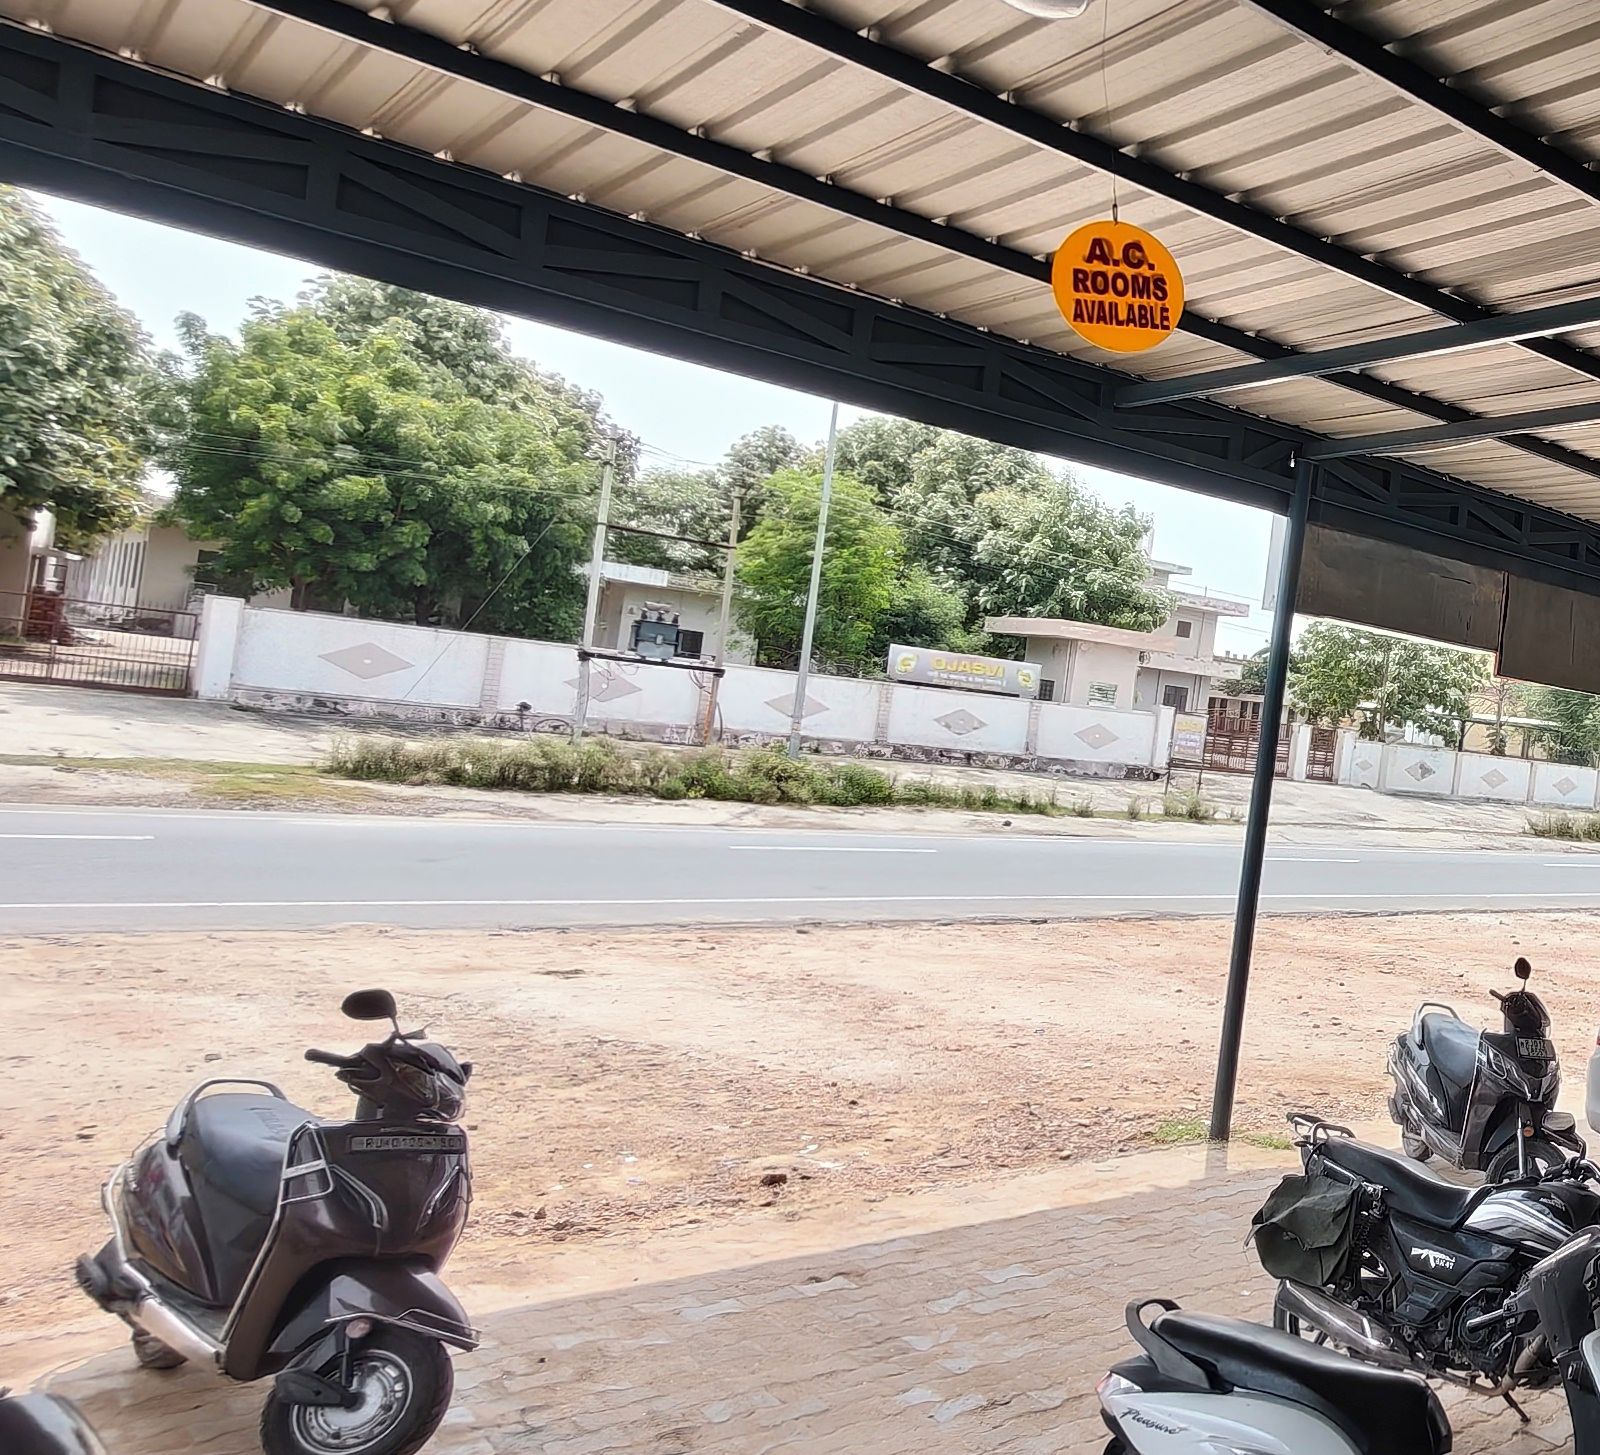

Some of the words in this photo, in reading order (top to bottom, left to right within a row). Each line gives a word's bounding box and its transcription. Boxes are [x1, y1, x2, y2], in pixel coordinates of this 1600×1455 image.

[1083, 238, 1156, 270] A.C.
[1072, 268, 1168, 301] ROOMS
[1072, 298, 1171, 331] AVAILABLE
[1119, 1407, 1188, 1435] Pleasure
